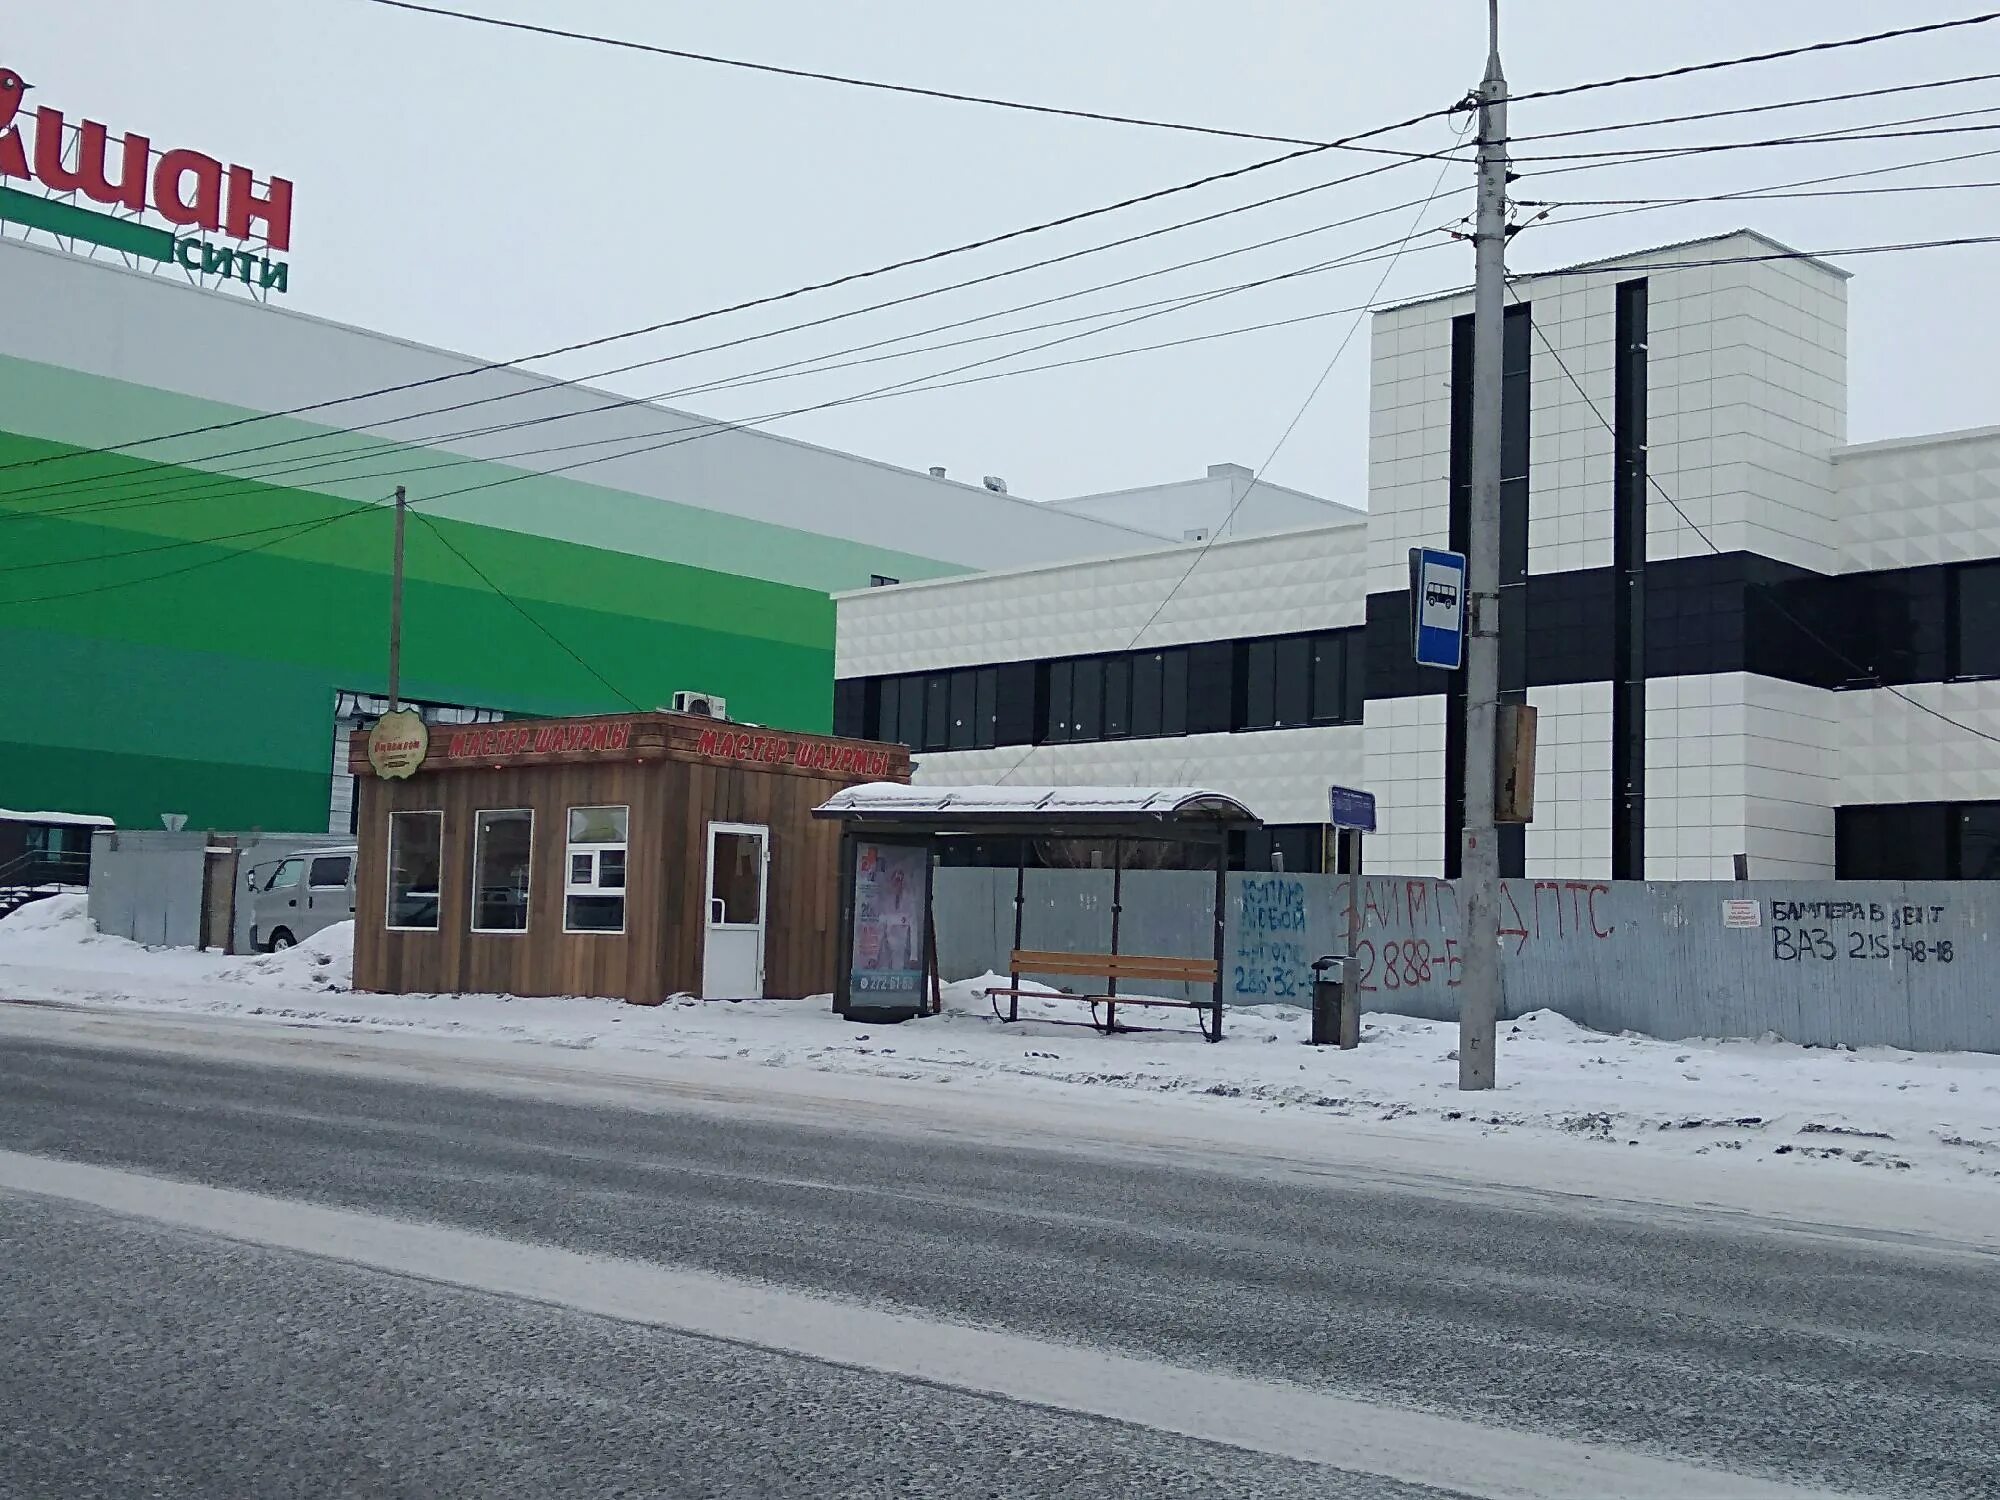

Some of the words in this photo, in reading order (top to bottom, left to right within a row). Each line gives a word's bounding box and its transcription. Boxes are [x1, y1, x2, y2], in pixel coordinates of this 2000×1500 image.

[449, 727, 529, 759] МАСТЕР
[534, 721, 632, 753] ШАУРМЫ
[696, 728, 789, 764] МАСТЕР
[794, 740, 889, 776] ШАУРМЫ
[1773, 926, 1837, 961] ВАЗ
